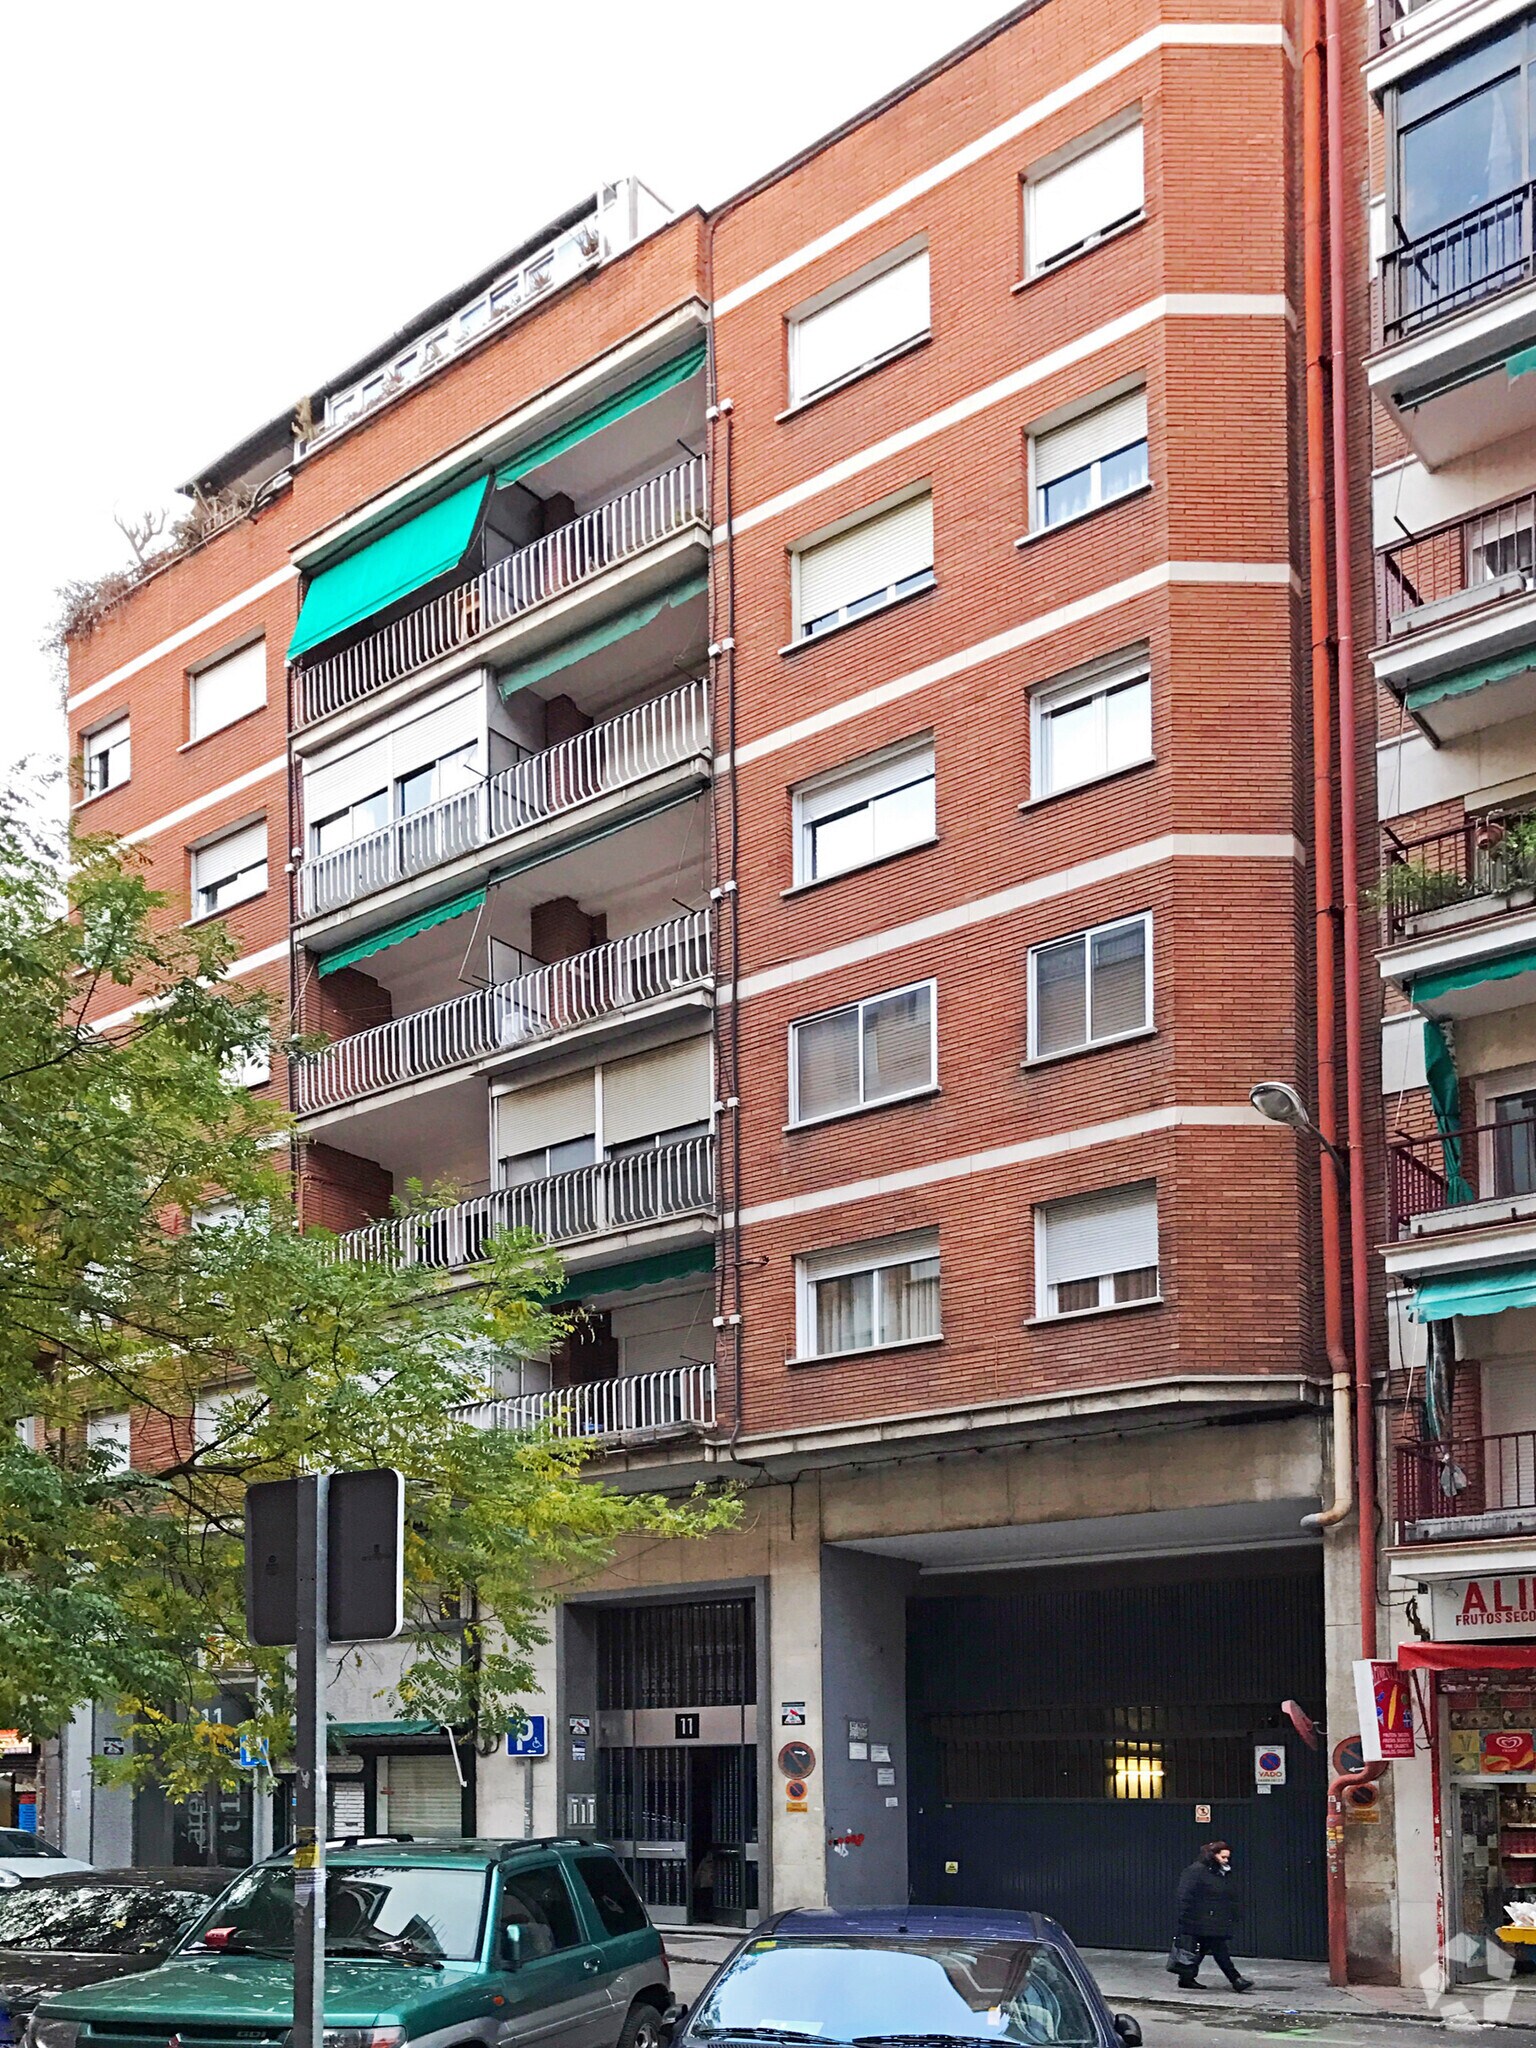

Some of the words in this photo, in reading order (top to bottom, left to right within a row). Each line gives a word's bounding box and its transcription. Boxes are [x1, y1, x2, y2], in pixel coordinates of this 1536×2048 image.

[1462, 1577, 1536, 1614] ALI
[1455, 1612, 1502, 1626] FRUTOS
[516, 1718, 534, 1751] P
[680, 1717, 693, 1735] 11
